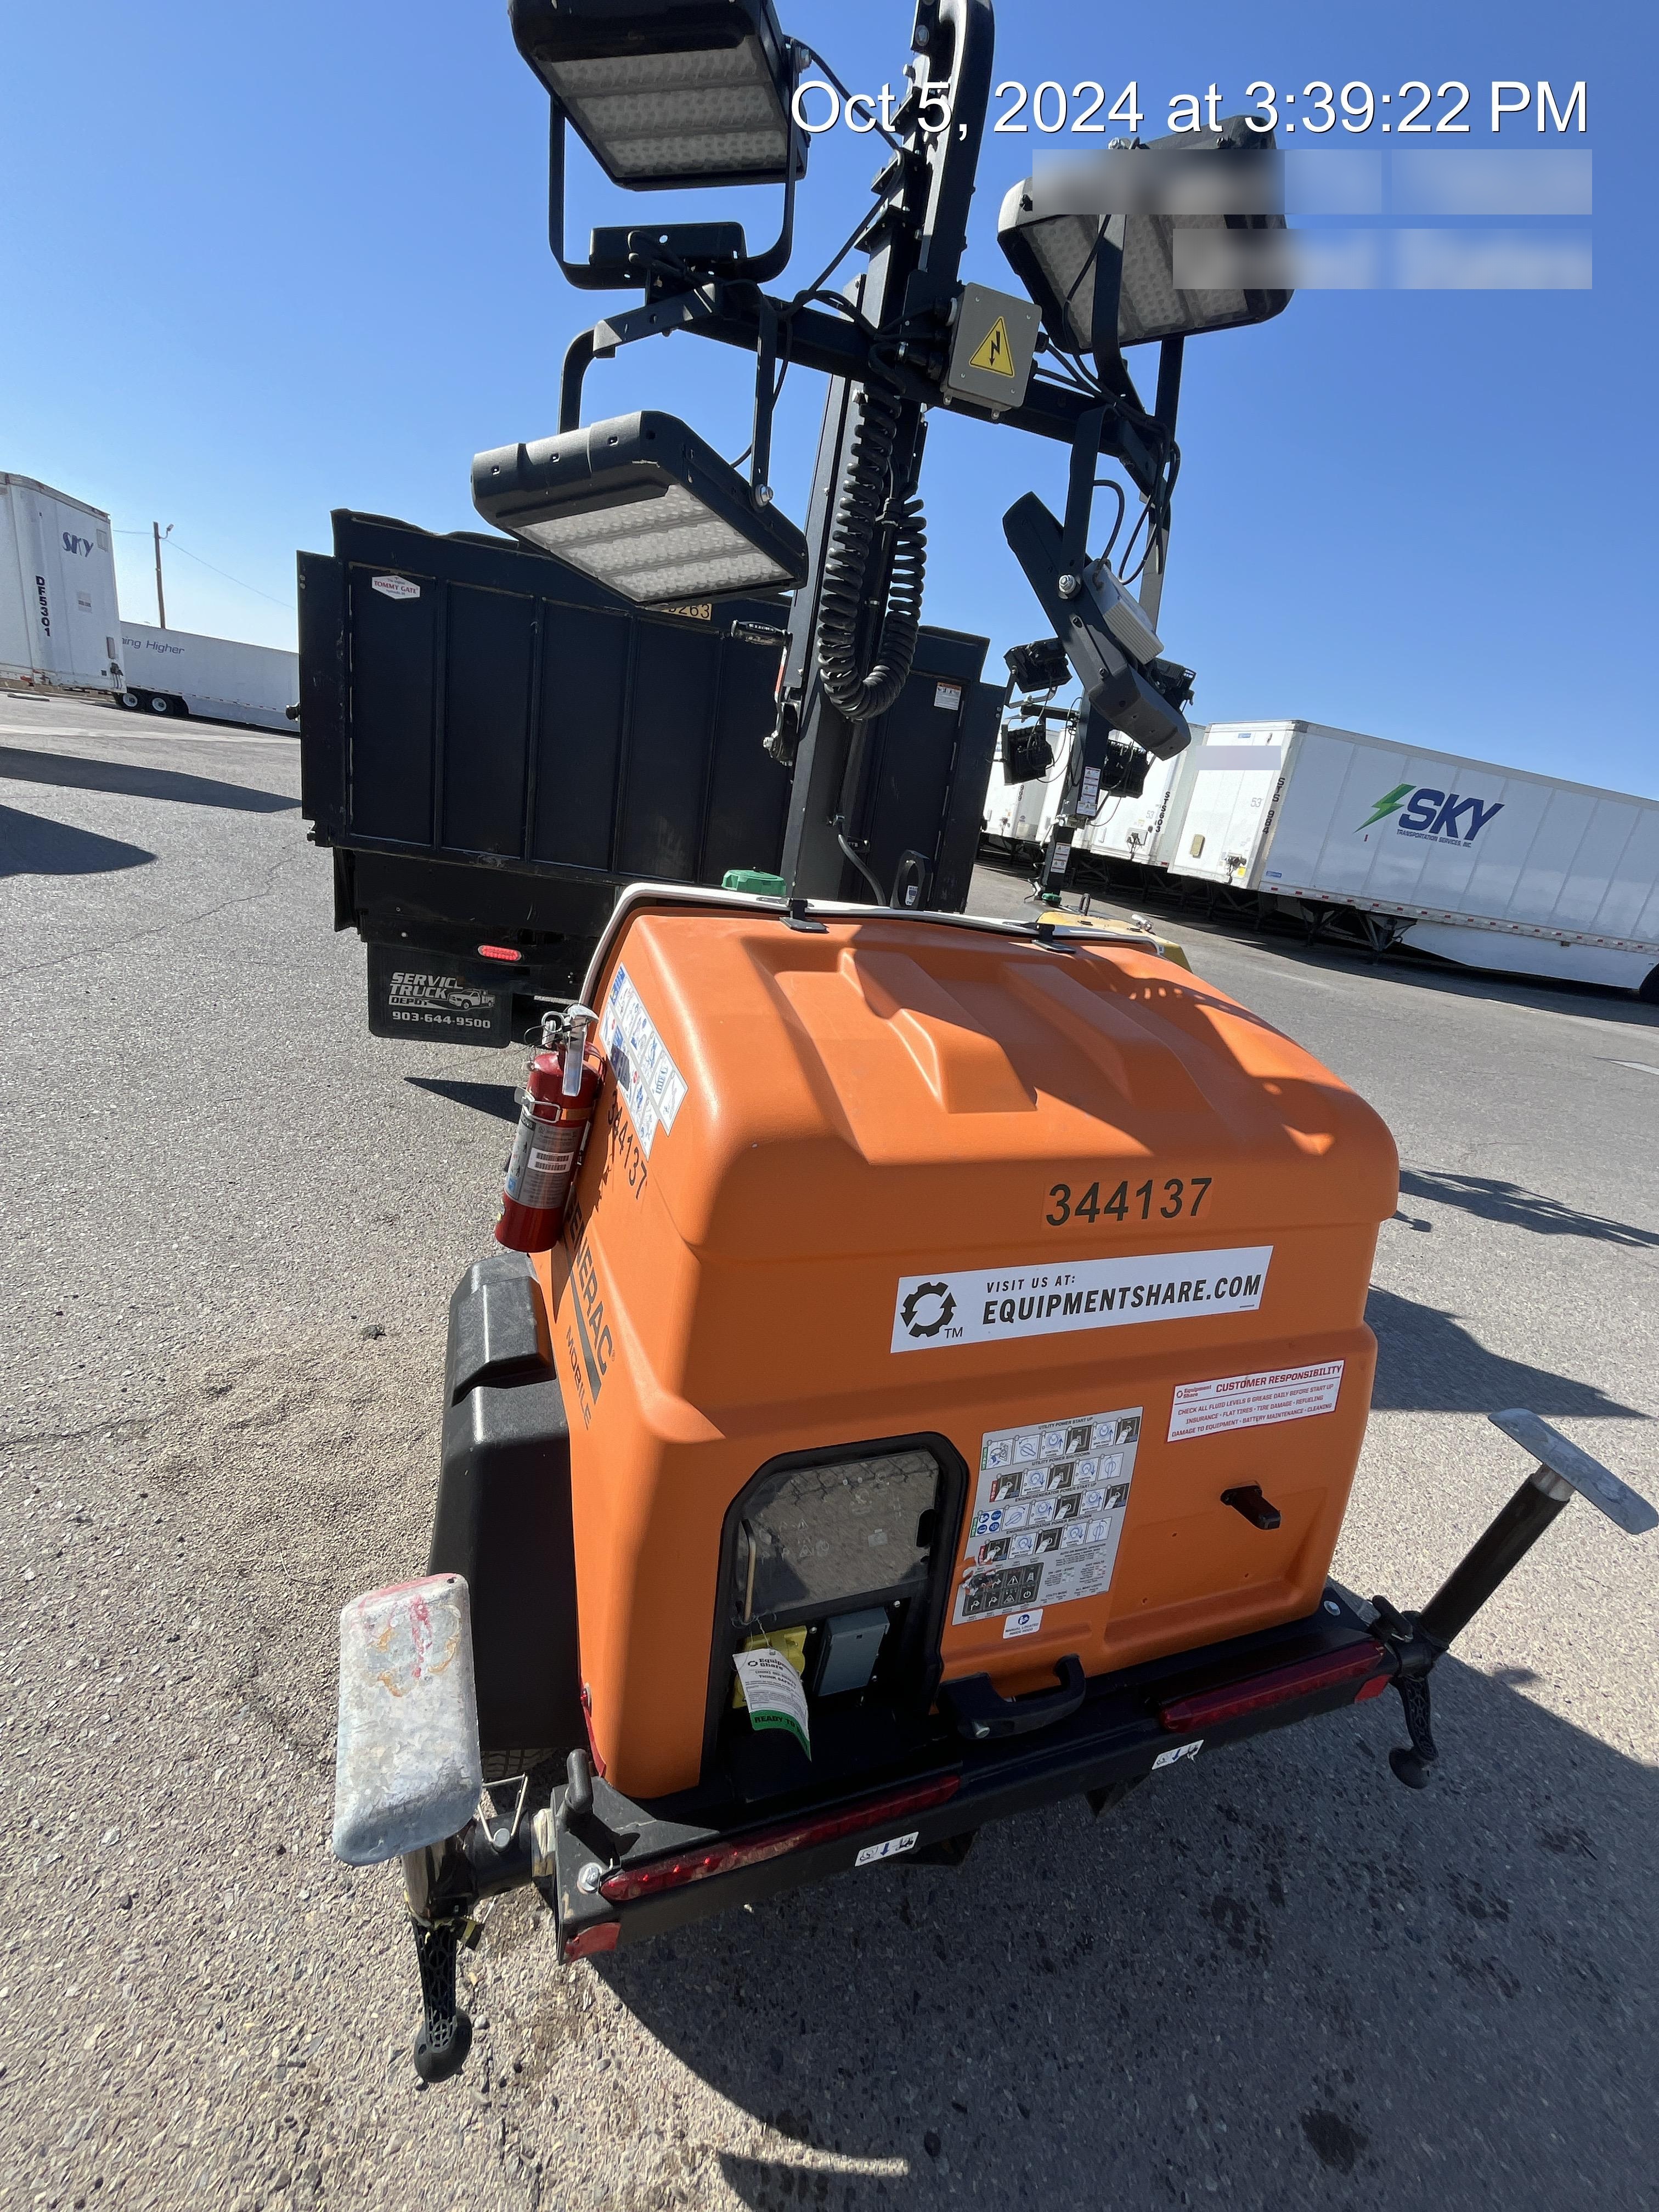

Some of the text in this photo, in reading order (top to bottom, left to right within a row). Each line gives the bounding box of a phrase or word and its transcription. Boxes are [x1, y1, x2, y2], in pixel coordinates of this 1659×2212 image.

[62, 532, 94, 557] SKY
[374, 580, 398, 590] TOMMY
[146, 640, 185, 654] Higher
[1272, 777, 1285, 802] STS
[1155, 791, 1170, 833] STS603
[1398, 788, 1505, 841] SKY
[1397, 829, 1438, 842] TRANSPORTATION
[390, 983, 448, 999] TRUCK
[391, 997, 428, 1006] DEPOT
[392, 1011, 491, 1029] 903-644-9500
[1046, 1177, 1212, 1226] 344137
[568, 1196, 612, 1376] ENERAC
[987, 1274, 1076, 1293] VISIT US AT:
[983, 1274, 1262, 1325] EQUIPMENTSHARE.COM
[944, 1327, 963, 1339] TM
[566, 1325, 591, 1431] MOBILE
[1184, 1385, 1211, 1393] Equipment
[1216, 1364, 1342, 1392] CUSTOMER RESPONSIBILITY
[1178, 1407, 1198, 1415] CHECK
[1209, 1402, 1226, 1410] FLUID
[1226, 1398, 1246, 1407] LEVELS
[1252, 1394, 1273, 1402] GREASE
[1289, 1387, 1309, 1396] BEFORE
[1186, 1413, 1219, 1424] INSURANCE
[1270, 1400, 1293, 1409] DAMAGE
[1296, 1395, 1324, 1405] REFUELING
[1172, 1427, 1195, 1437] DAMAGE
[1205, 1419, 1239, 1430] EQUIPMENT
[1242, 1414, 1266, 1424] BATTERY
[1266, 1408, 1304, 1419] MAINTENANCE
[1307, 1403, 1332, 1412] CLEANING
[1068, 1514, 1092, 1522] SHUTDOWN
[754, 1715, 783, 1723] READY
